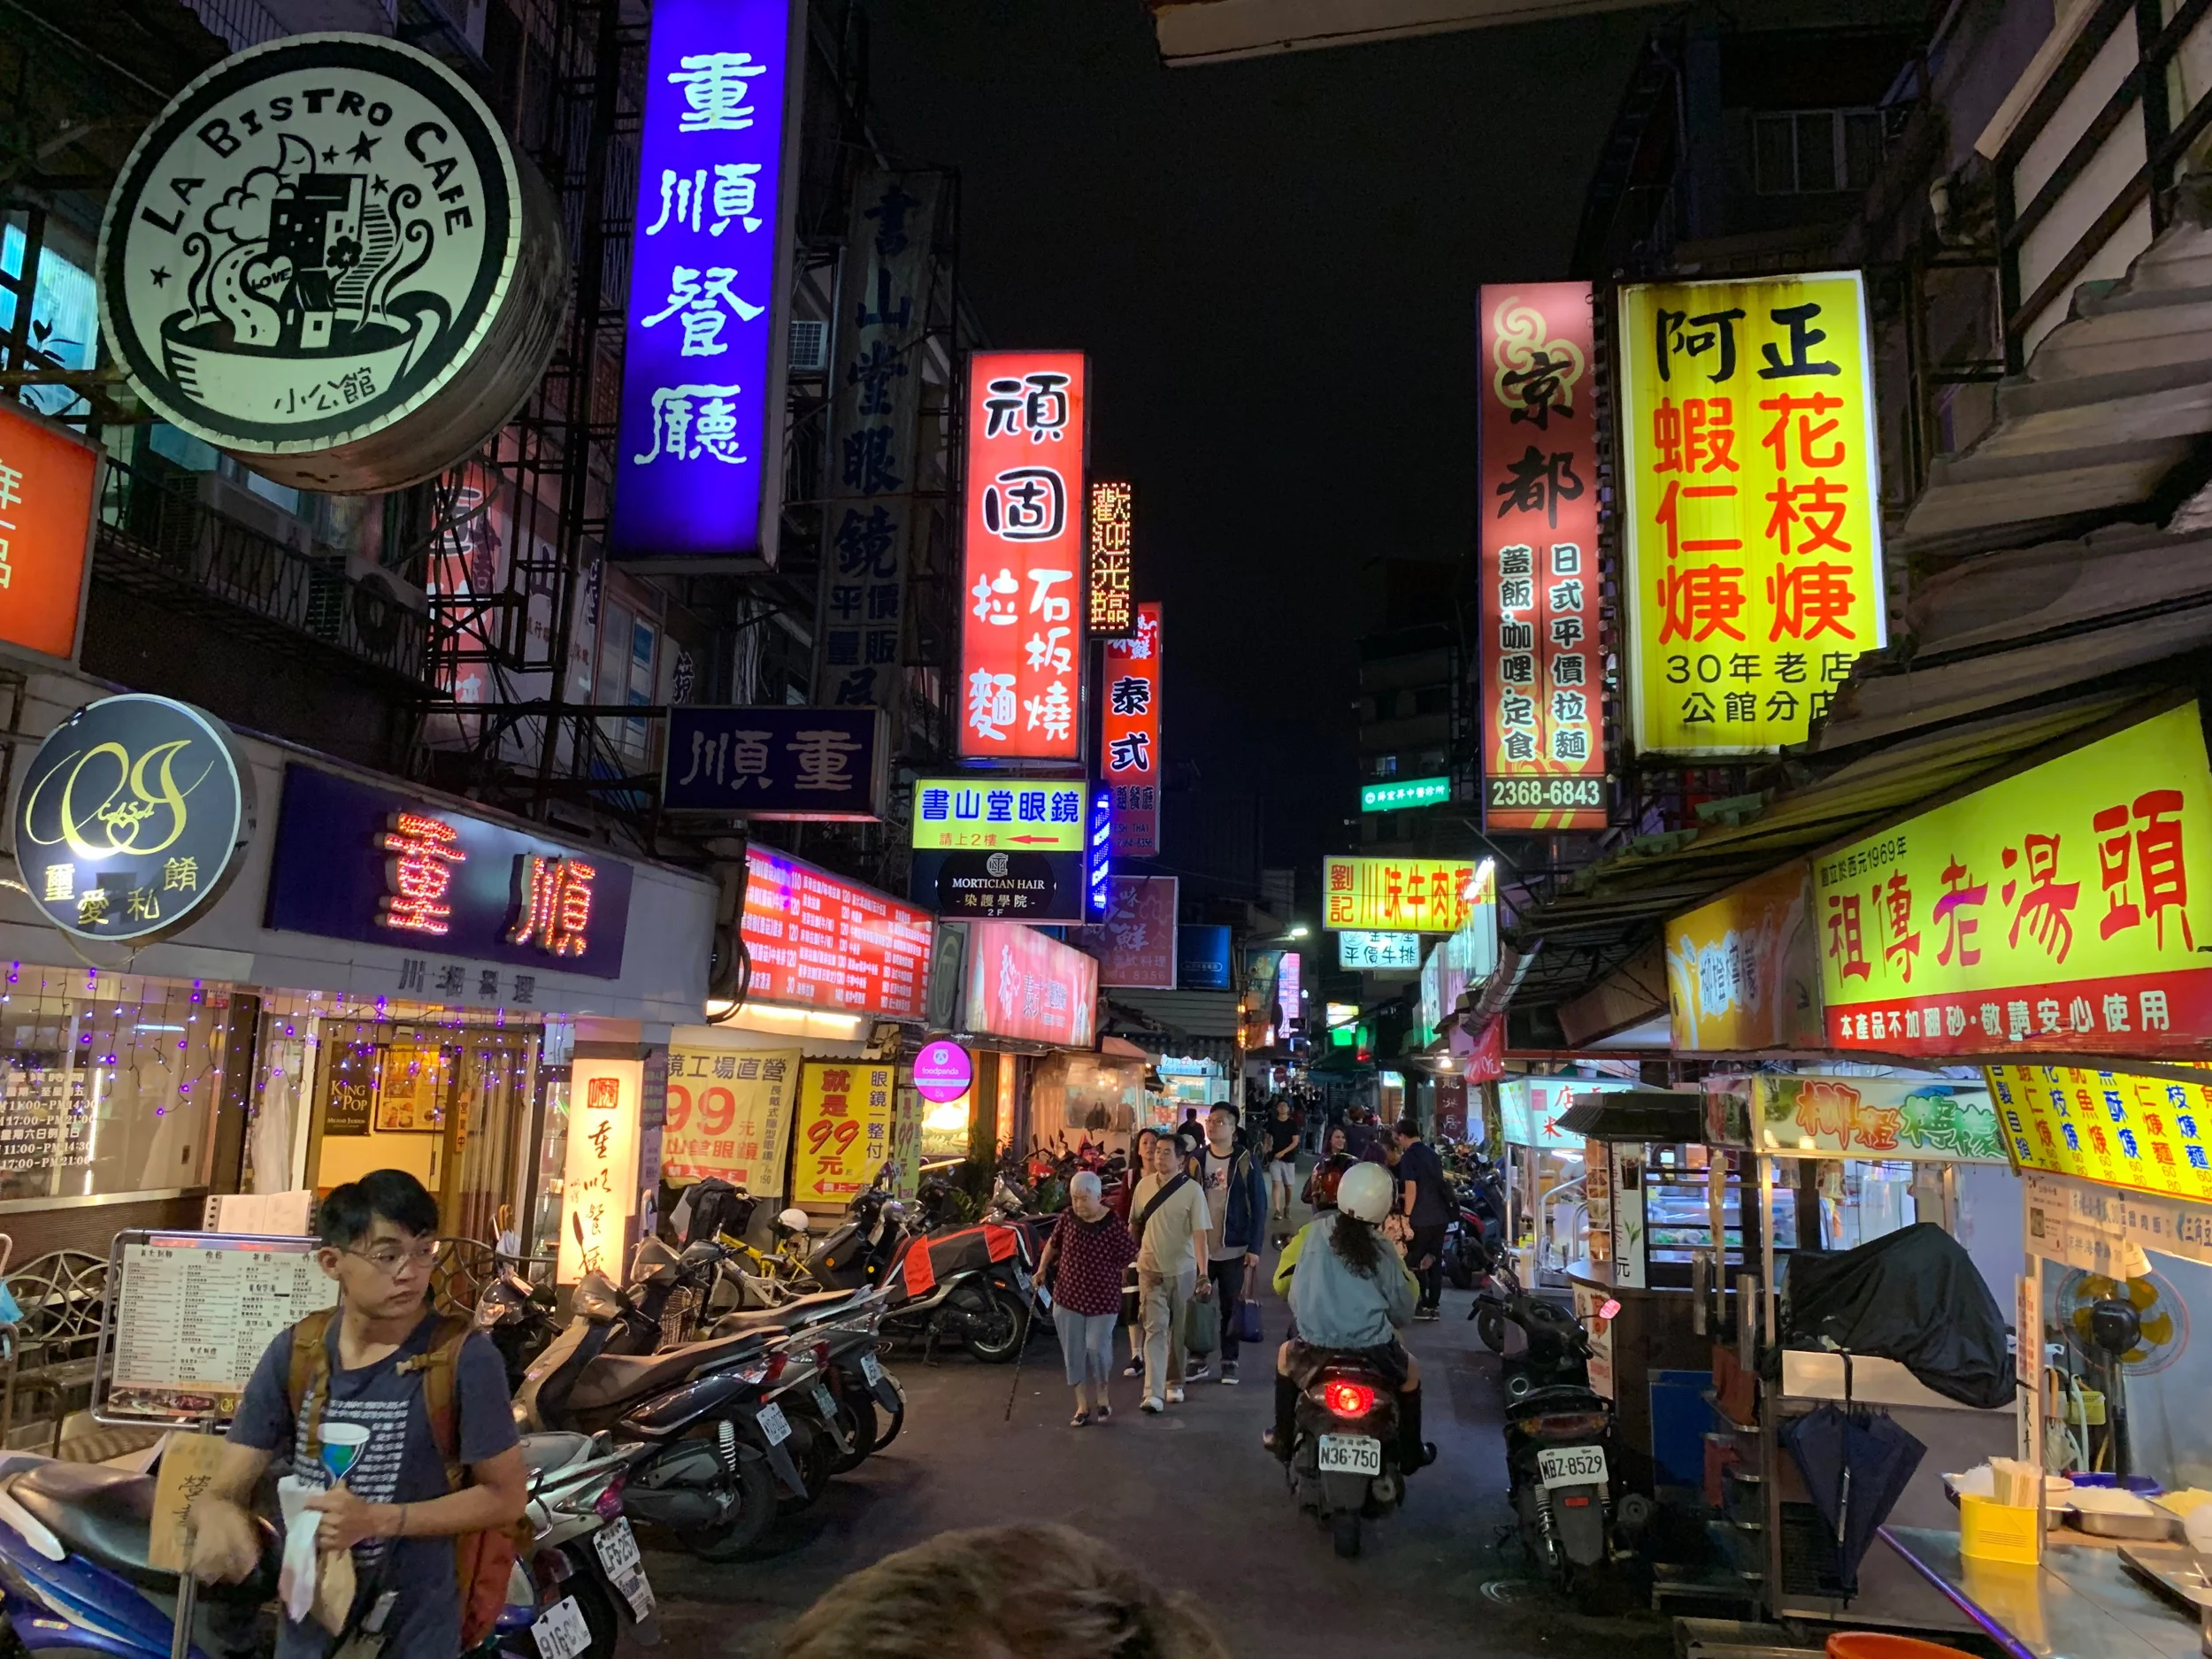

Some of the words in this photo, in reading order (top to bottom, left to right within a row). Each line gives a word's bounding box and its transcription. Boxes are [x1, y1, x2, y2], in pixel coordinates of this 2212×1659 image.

[140, 175, 205, 236] LA
[196, 88, 393, 159] BISTRO
[404, 121, 473, 237] CAFE
[251, 267, 293, 290] LOVE
[273, 365, 376, 414] 小公館
[1496, 350, 1585, 530] 京都
[983, 372, 1071, 543] 頑固
[968, 568, 1020, 741] 拉麵
[1023, 567, 1073, 741] 石板燒
[1549, 543, 1590, 763] 日式平價拉麵
[1666, 651, 1854, 686] 30年老店
[1109, 675, 1151, 773] 泰式
[1493, 777, 1601, 808] 2368-6843
[921, 789, 1079, 824] 書山堂眼鏡
[939, 833, 998, 847] 請上2樓
[379, 811, 597, 959] 重順
[952, 878, 1015, 890] MORTICIAN
[1017, 879, 1045, 890] HAIR
[1330, 864, 1355, 924] 劉記
[1828, 788, 2194, 989] 祖傳老湯頭
[789, 896, 800, 916] 120
[1360, 863, 1482, 929] 川味牛肉麵
[788, 923, 799, 942] 120
[787, 949, 796, 968] 120
[1344, 946, 1417, 964] 平價牛排
[667, 1052, 787, 1083] 鏡工場直營
[921, 1065, 959, 1077] foodpanda
[330, 1079, 366, 1096] KING
[342, 1094, 368, 1111] POP
[866, 1071, 888, 1159] 眼鏡一整付
[1795, 1080, 2008, 1160] 柳橙檸檬
[738, 1120, 756, 1137] 元
[2071, 1152, 2085, 1164] 60
[2098, 1156, 2112, 1167] 60
[2128, 1160, 2143, 1172] 60
[2077, 1165, 2089, 1177] 80
[2103, 1169, 2117, 1181] 80
[2132, 1173, 2147, 1187] 80
[2162, 1165, 2177, 1179] 60
[2196, 1170, 2212, 1183] 60
[2166, 1179, 2182, 1193] 80
[1320, 1446, 1379, 1470] N36-750
[1540, 1455, 1603, 1481] MBZ-8529
